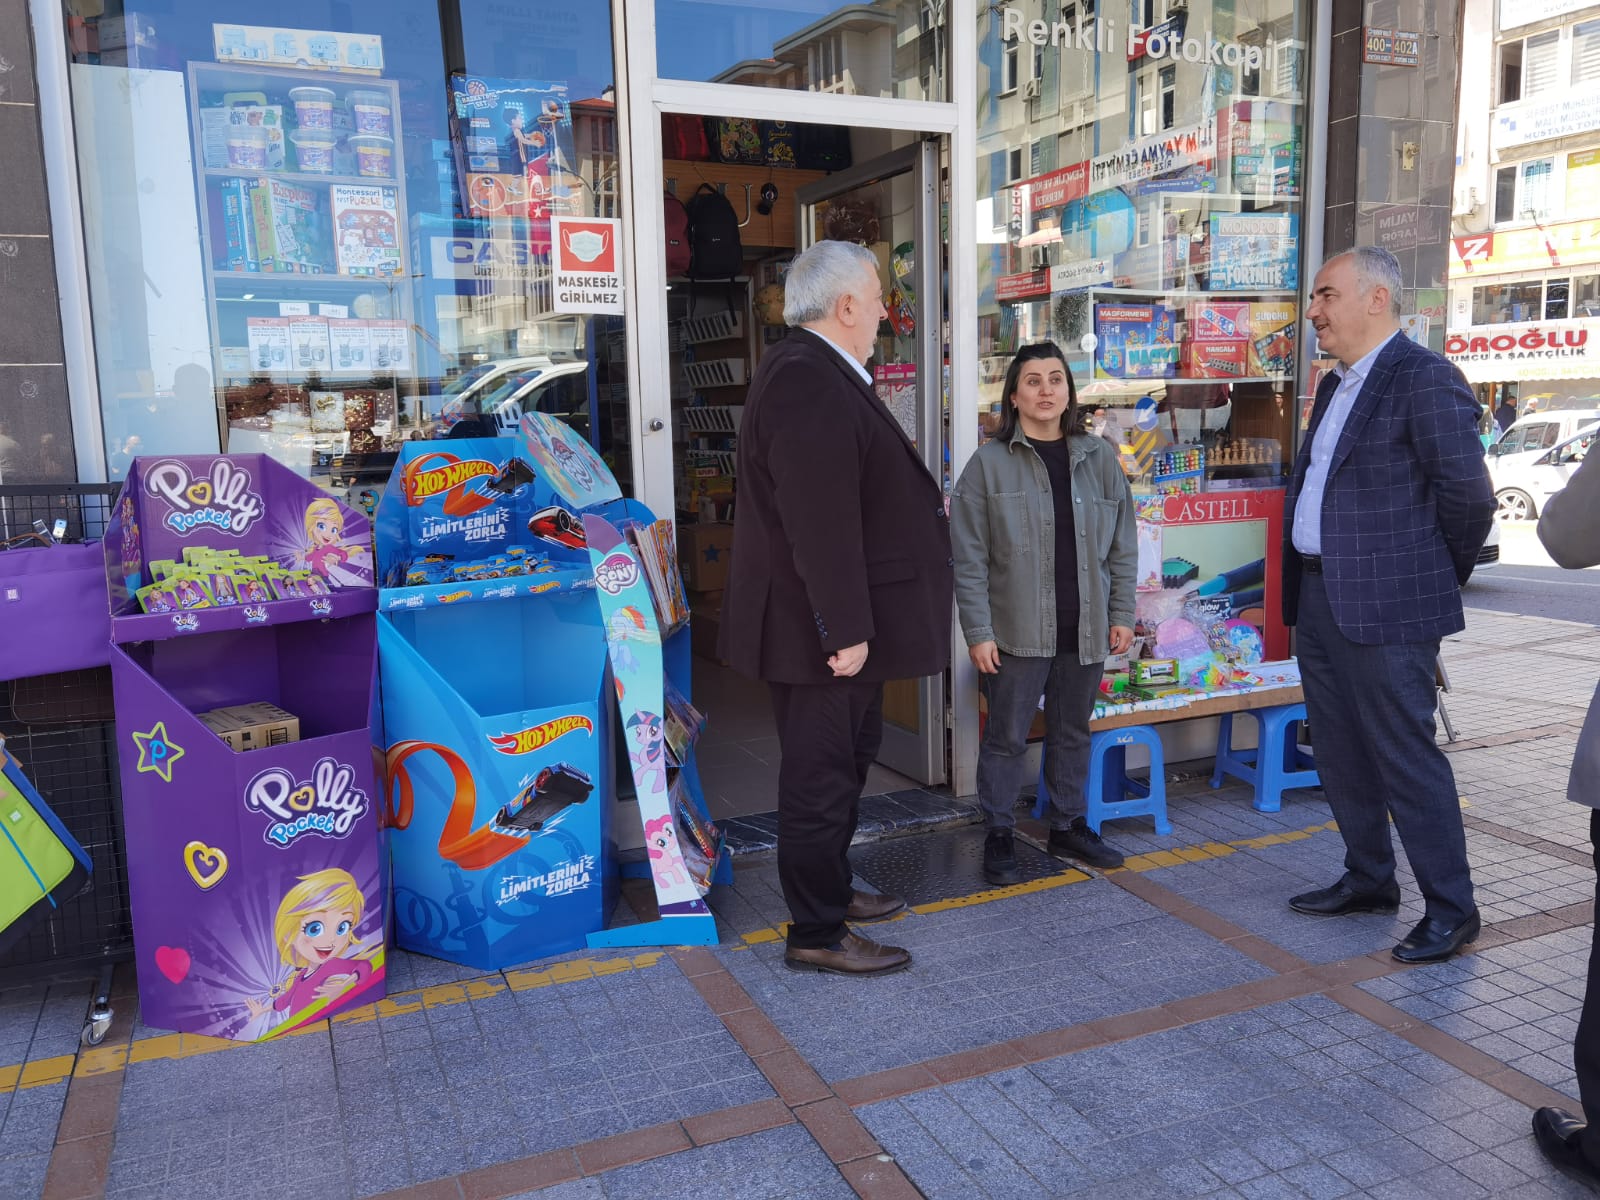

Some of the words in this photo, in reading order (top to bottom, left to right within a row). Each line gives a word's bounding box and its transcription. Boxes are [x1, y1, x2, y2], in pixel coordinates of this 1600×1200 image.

[1003, 7, 1115, 53] Renkli
[1127, 24, 1273, 76] Fotokopi
[336, 187, 380, 196] Montessori
[1221, 219, 1287, 234] MONOPOLY
[558, 275, 619, 289] MASKESİZ
[1226, 265, 1282, 286] FORTNITE
[560, 292, 618, 304] GİRİLMEZ
[1255, 311, 1288, 321] SUDOKU
[414, 468, 450, 497] HOT
[150, 460, 261, 532] Polly
[168, 508, 233, 532] Pocket
[1162, 495, 1253, 522] CASTELL
[422, 511, 501, 538] LİMİTLERİNİ
[464, 524, 507, 541] ZORLA
[1199, 603, 1220, 613] glow
[514, 731, 545, 754] HOT
[250, 762, 364, 833] Polly
[270, 814, 334, 843] Pocket
[501, 860, 585, 900] LİMİTLERİNİ
[546, 872, 590, 896] ZORLA
